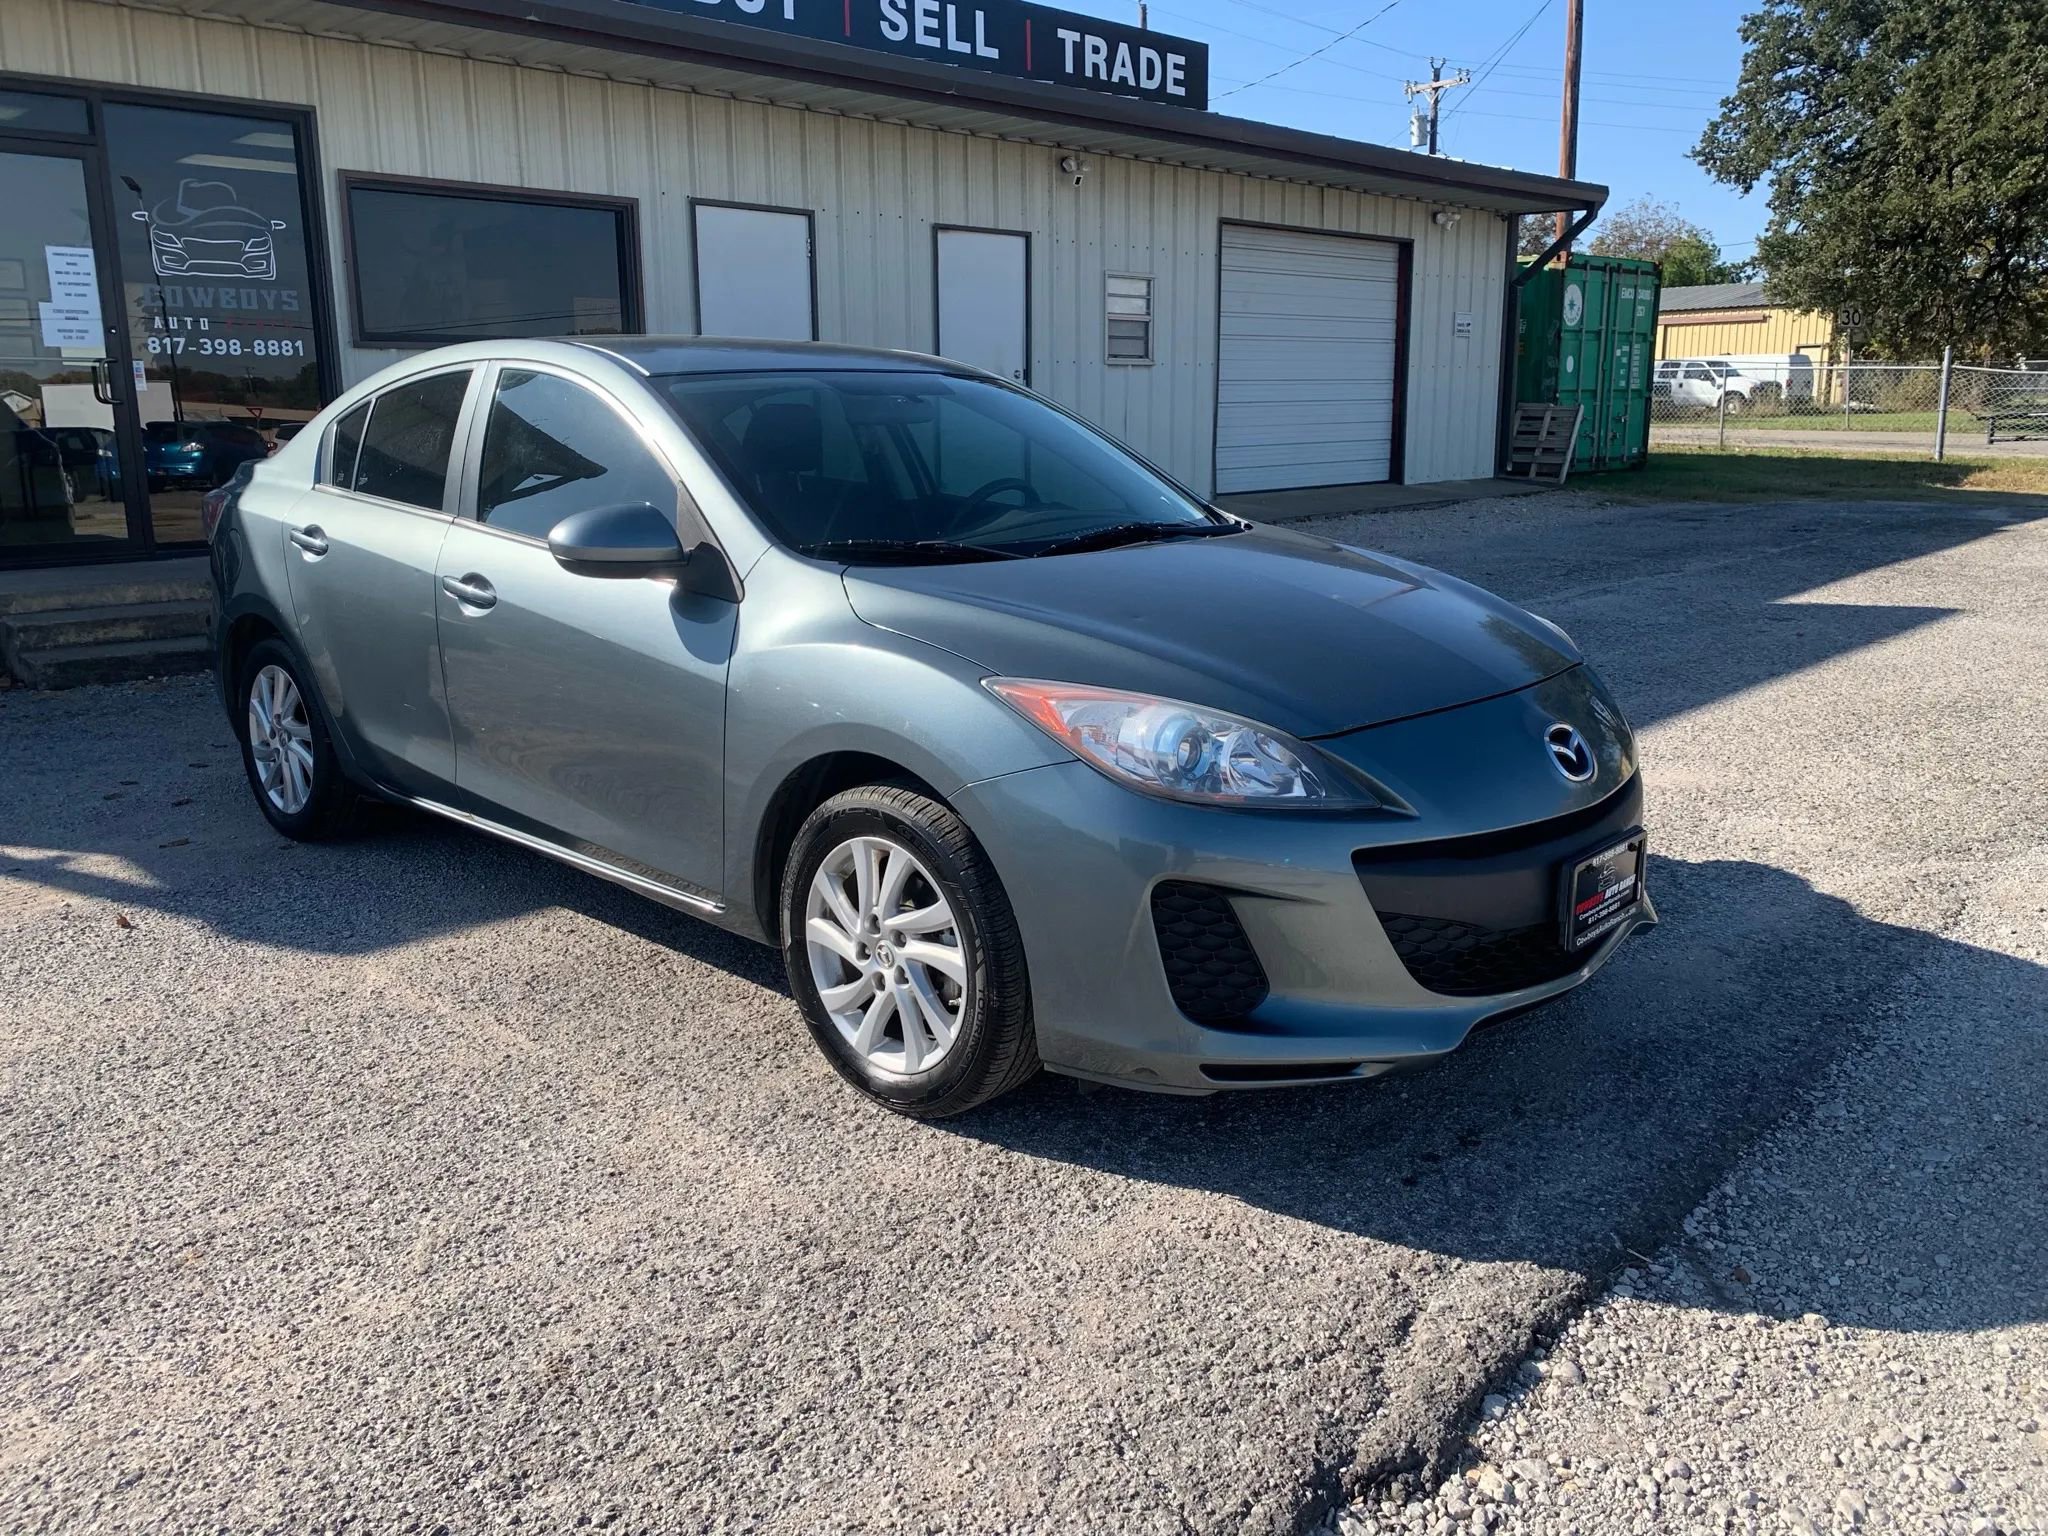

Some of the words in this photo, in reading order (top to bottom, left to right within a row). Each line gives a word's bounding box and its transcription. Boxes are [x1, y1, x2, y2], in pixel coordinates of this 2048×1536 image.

[880, 0, 999, 59] SELL
[1057, 28, 1185, 96] TRADE
[143, 285, 300, 311] COWBOYS
[154, 316, 209, 330] AUTO
[1842, 310, 1861, 325] 30
[147, 337, 304, 356] 817-398-8881
[1604, 883, 1619, 899] AUTO
